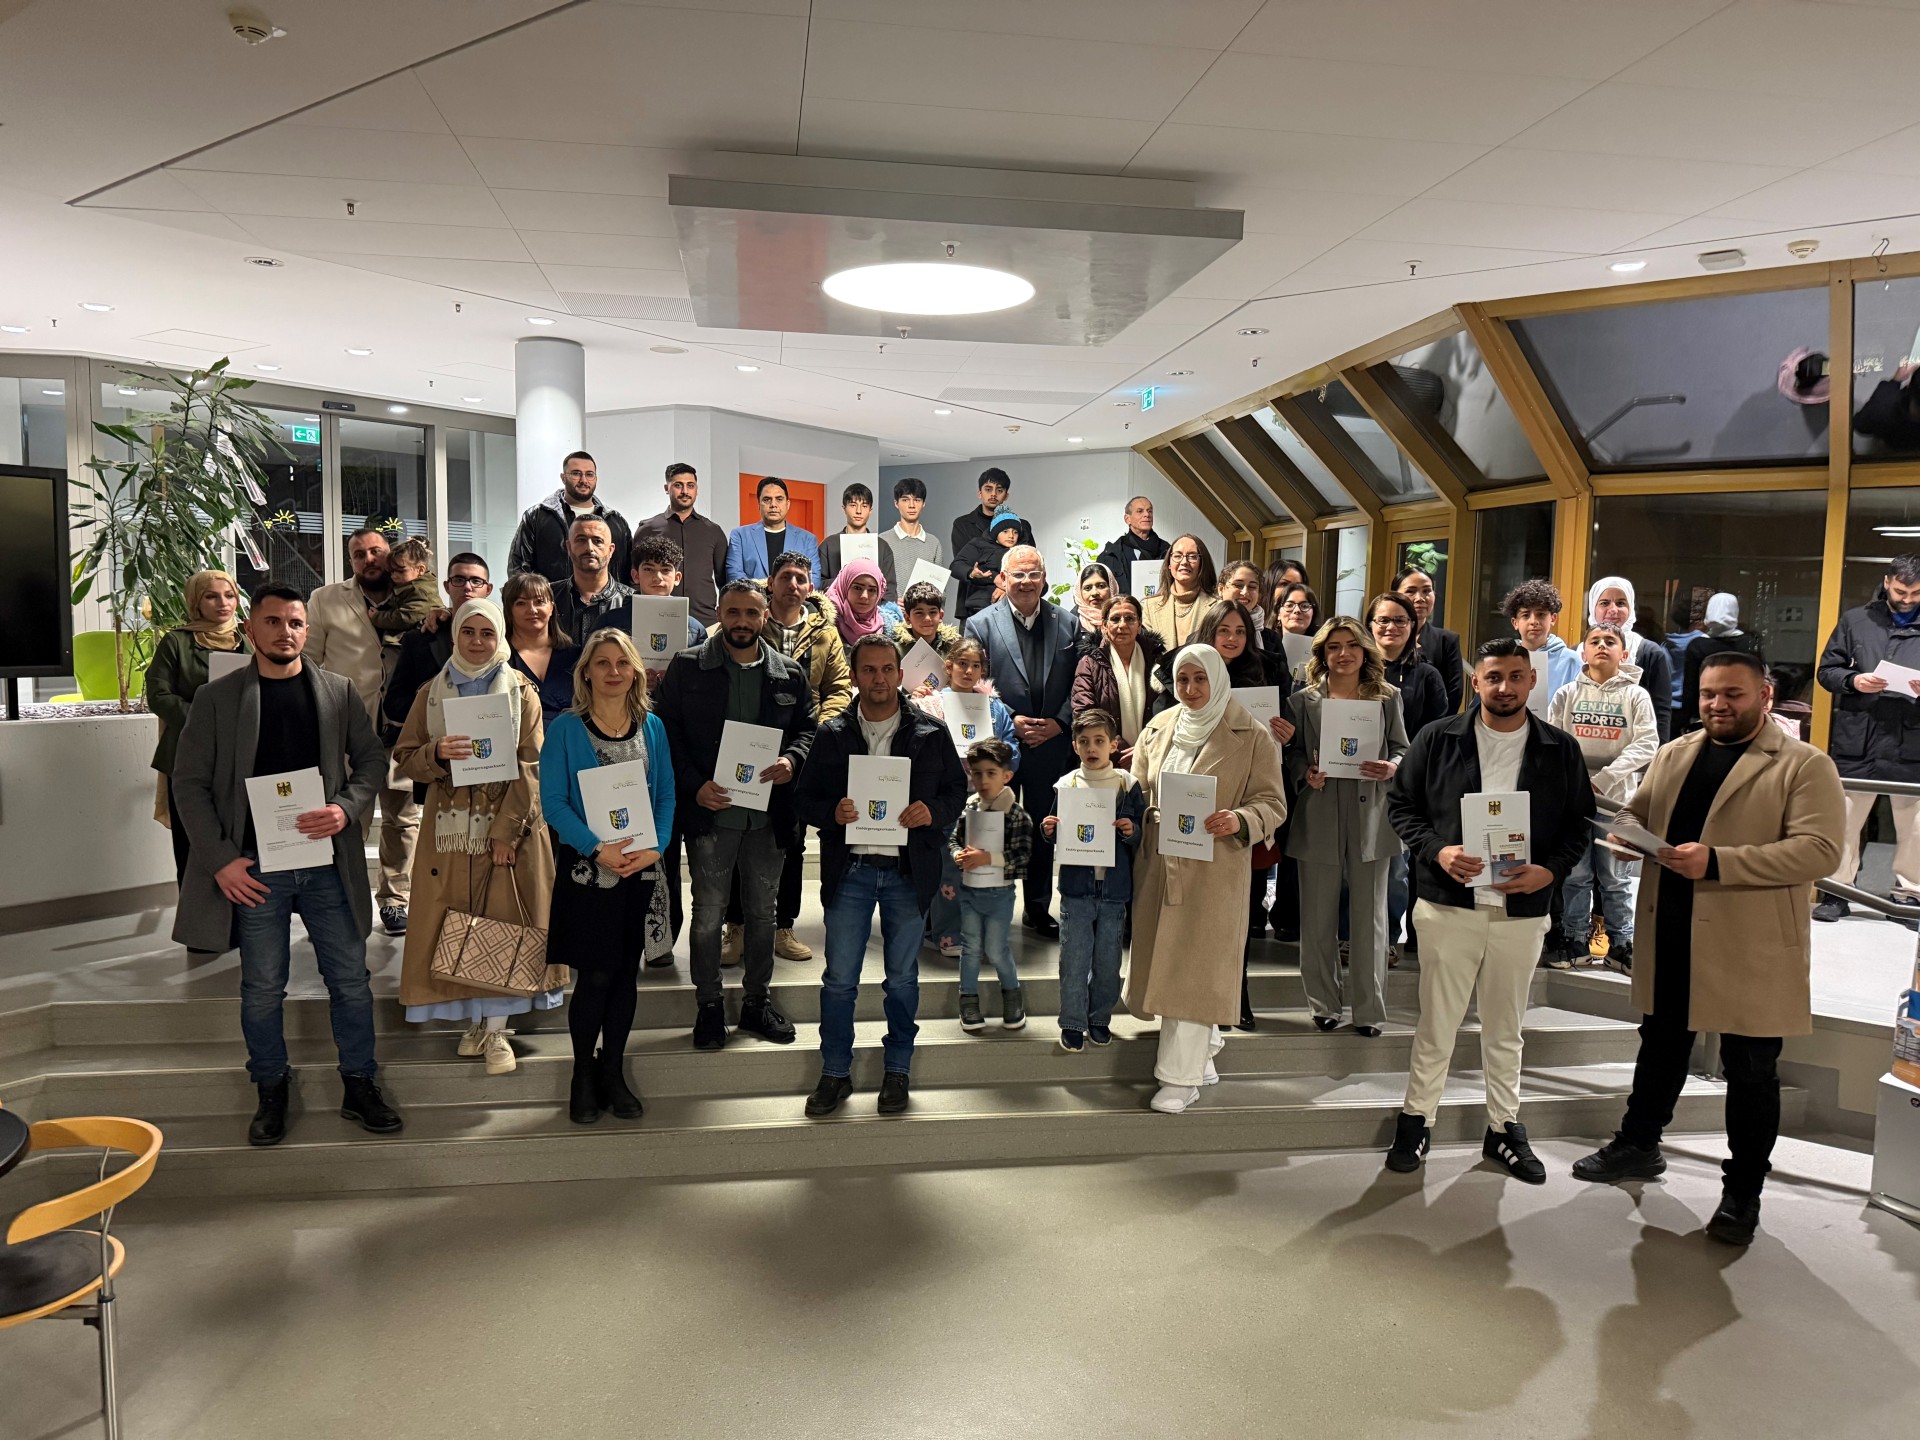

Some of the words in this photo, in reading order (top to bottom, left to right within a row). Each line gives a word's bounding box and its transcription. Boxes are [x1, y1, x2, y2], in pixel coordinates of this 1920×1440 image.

[1579, 701, 1619, 713] ENJOY
[1574, 713, 1624, 726] SPORTS
[1577, 726, 1618, 739] TODAY
